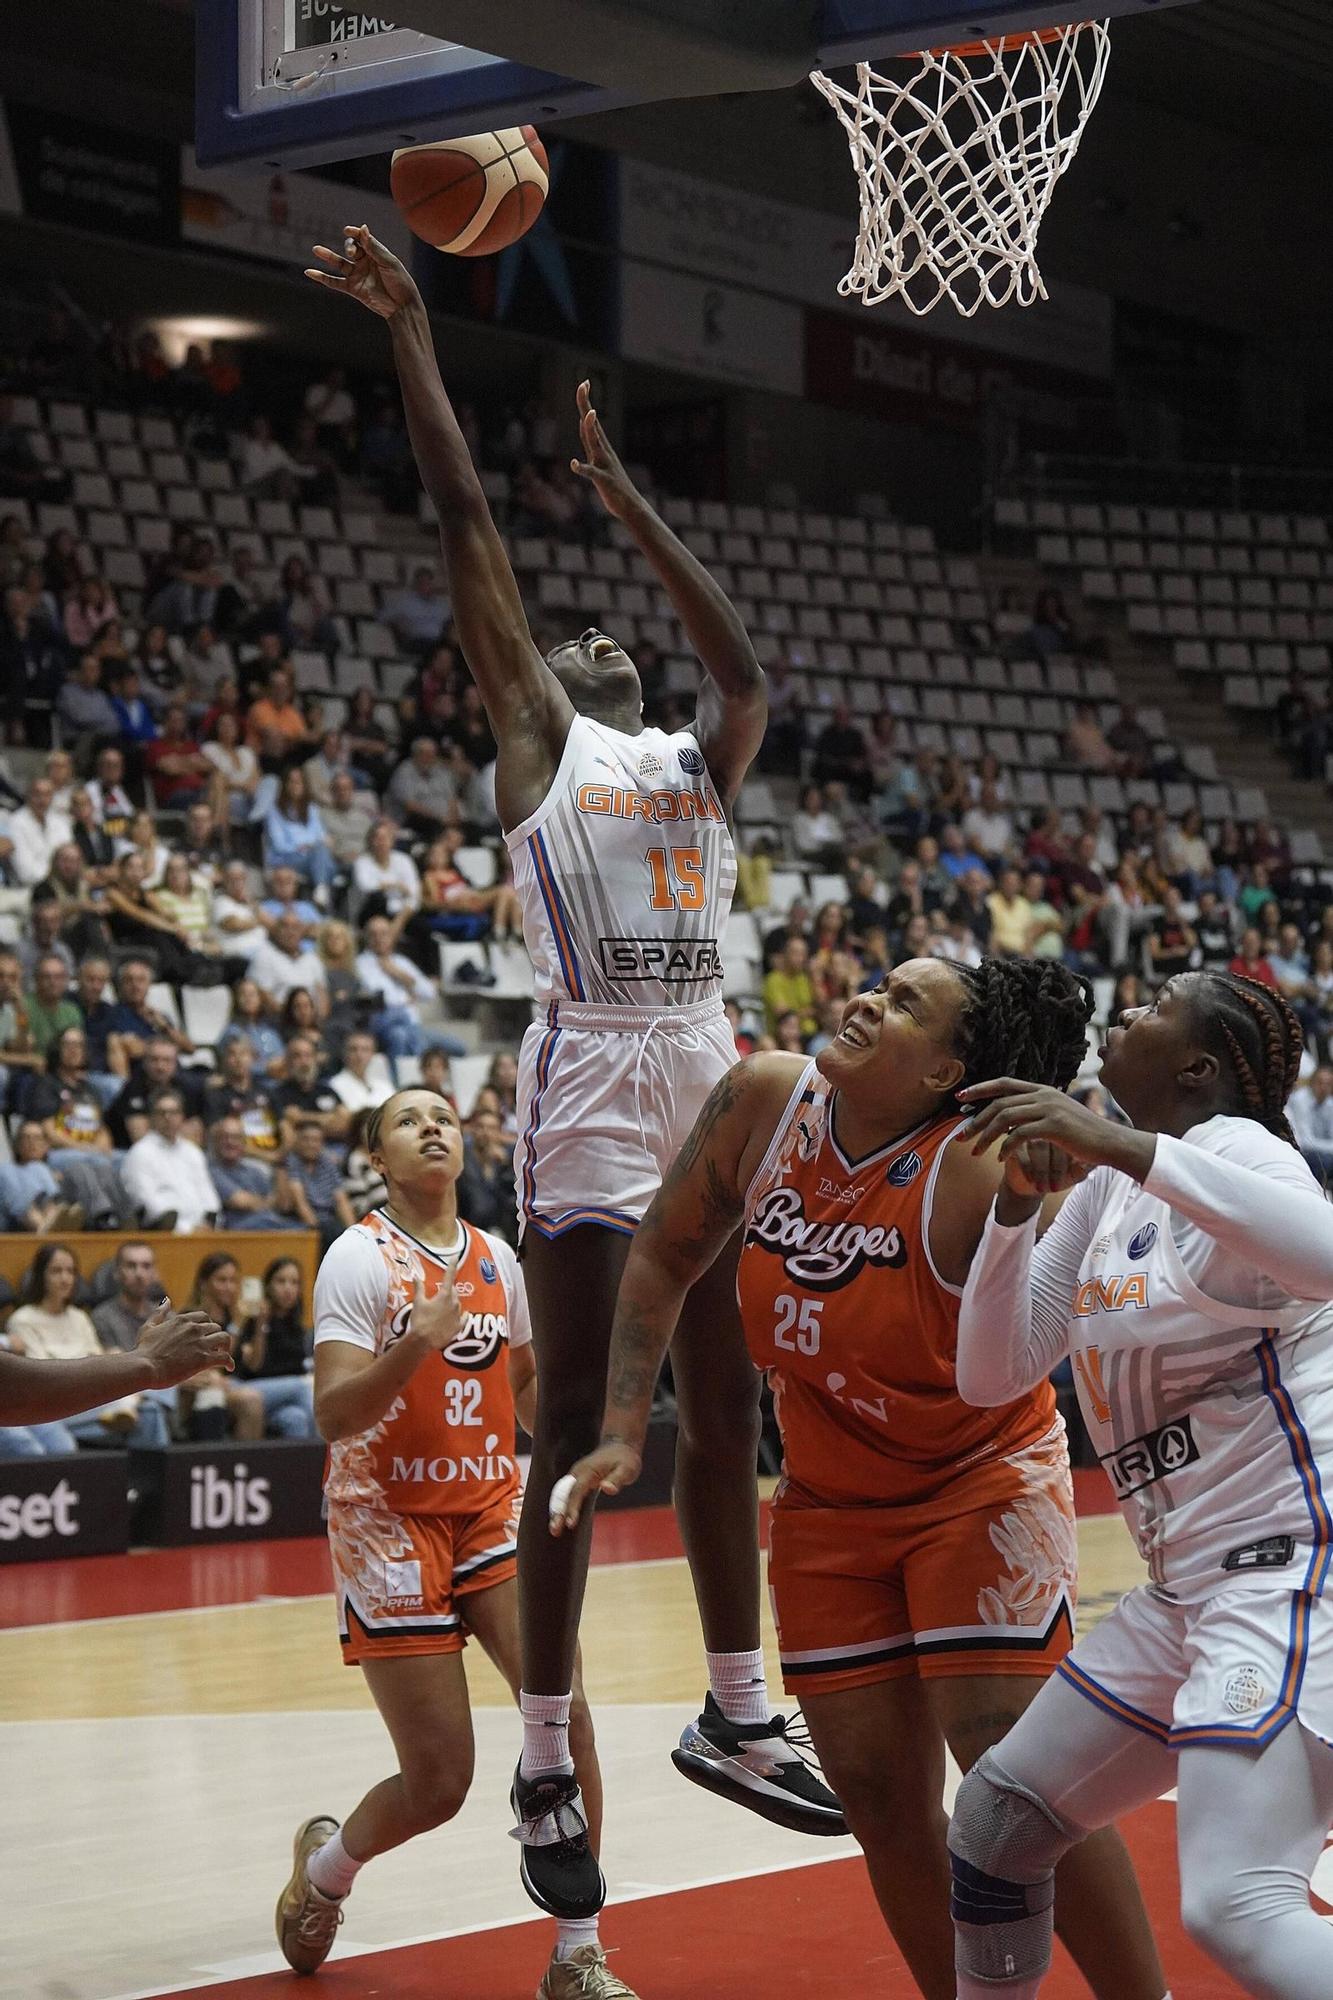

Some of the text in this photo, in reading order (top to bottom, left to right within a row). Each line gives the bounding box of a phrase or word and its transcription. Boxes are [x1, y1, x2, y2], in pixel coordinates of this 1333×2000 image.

[577, 783, 725, 824] GIRONA
[645, 847, 707, 912] 15
[774, 1294, 824, 1356] 25
[444, 1378, 484, 1427] 32
[190, 1462, 272, 1530] ibis
[387, 1596, 424, 1608] PHM
